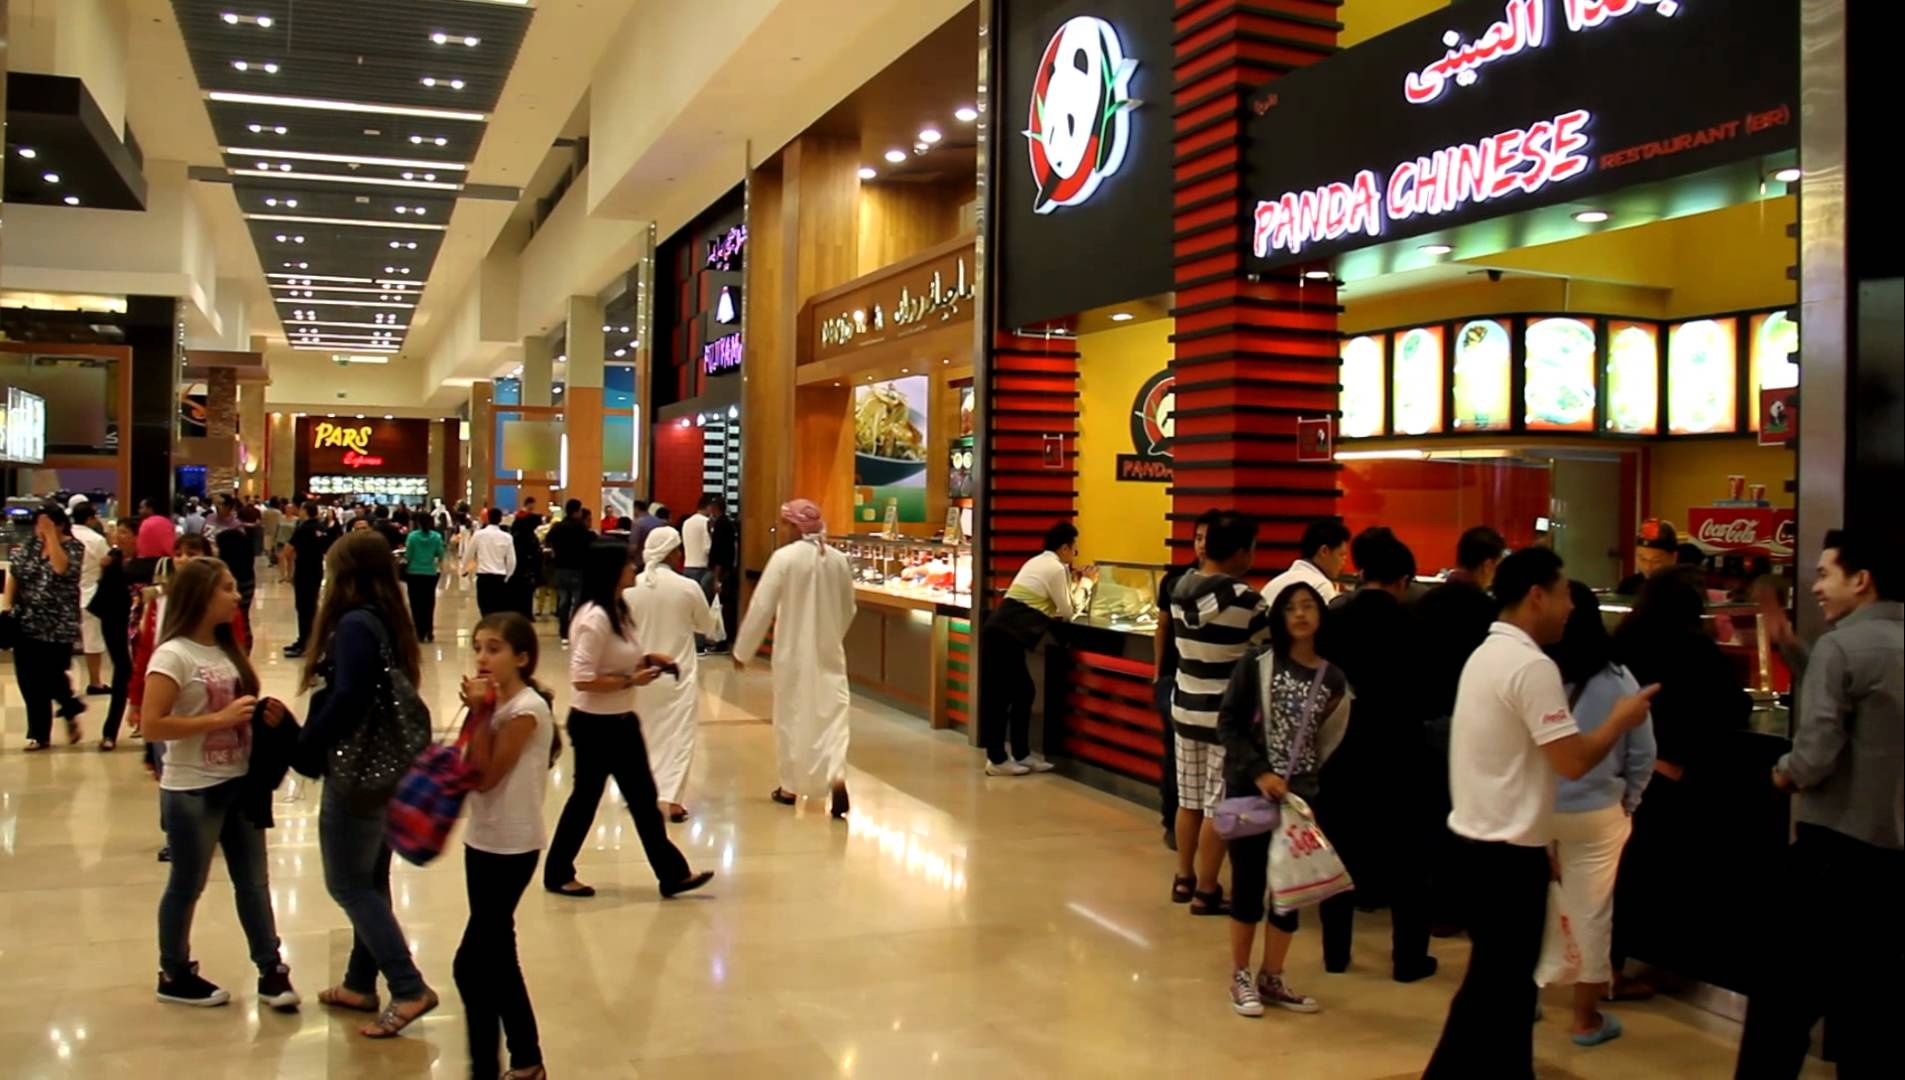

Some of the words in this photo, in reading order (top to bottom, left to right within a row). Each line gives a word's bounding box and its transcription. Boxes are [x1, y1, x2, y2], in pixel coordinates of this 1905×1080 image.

[1254, 169, 1380, 257] PANDA
[1387, 109, 1589, 219] CHINESE
[1600, 120, 1740, 170] RESTAURANT
[314, 422, 372, 455] PARS
